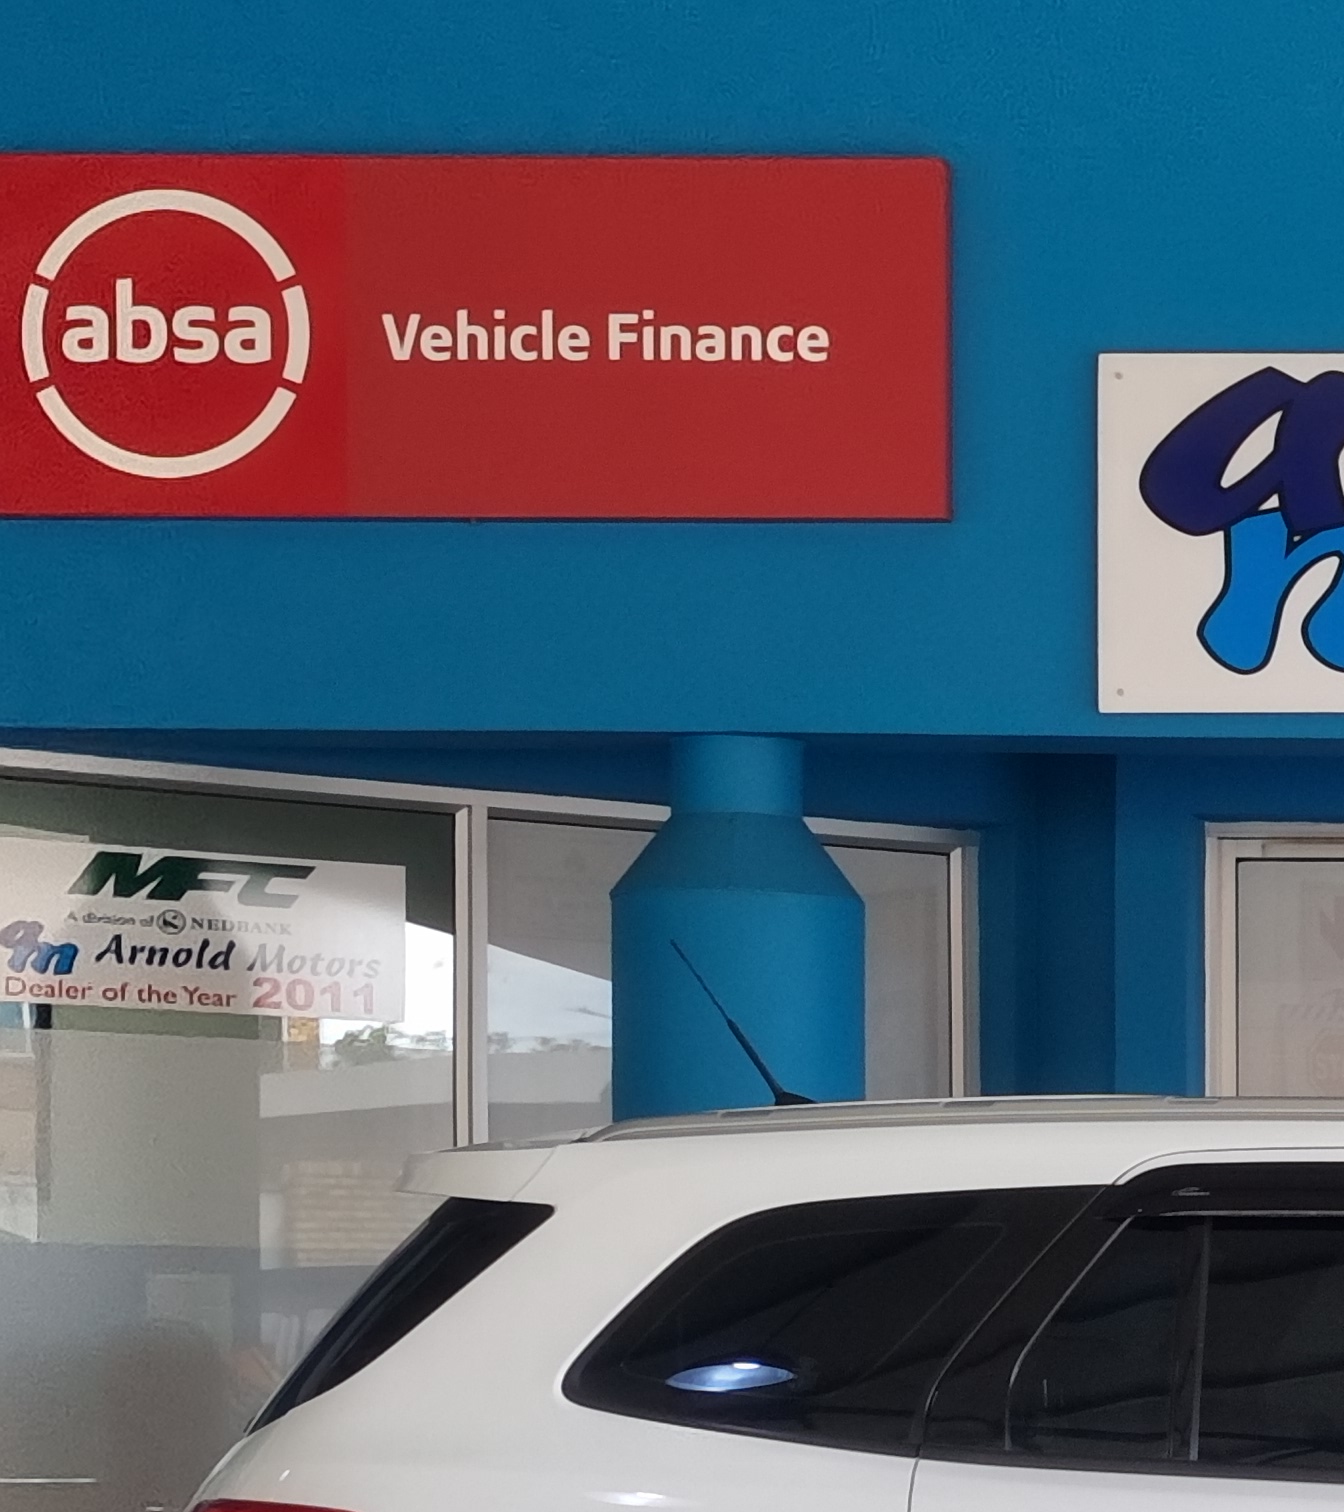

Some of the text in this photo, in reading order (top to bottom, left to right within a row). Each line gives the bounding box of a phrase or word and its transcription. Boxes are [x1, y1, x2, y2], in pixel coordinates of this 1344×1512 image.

[61, 278, 273, 363] absa
[382, 309, 829, 362] Vehicle Finance
[67, 851, 316, 909] MFC
[191, 917, 292, 936] NEDBANK
[95, 933, 236, 970] Arnold
[247, 943, 382, 979] Motors
[5, 976, 237, 1008] Dealer of the Year
[252, 976, 374, 1015] 2011
